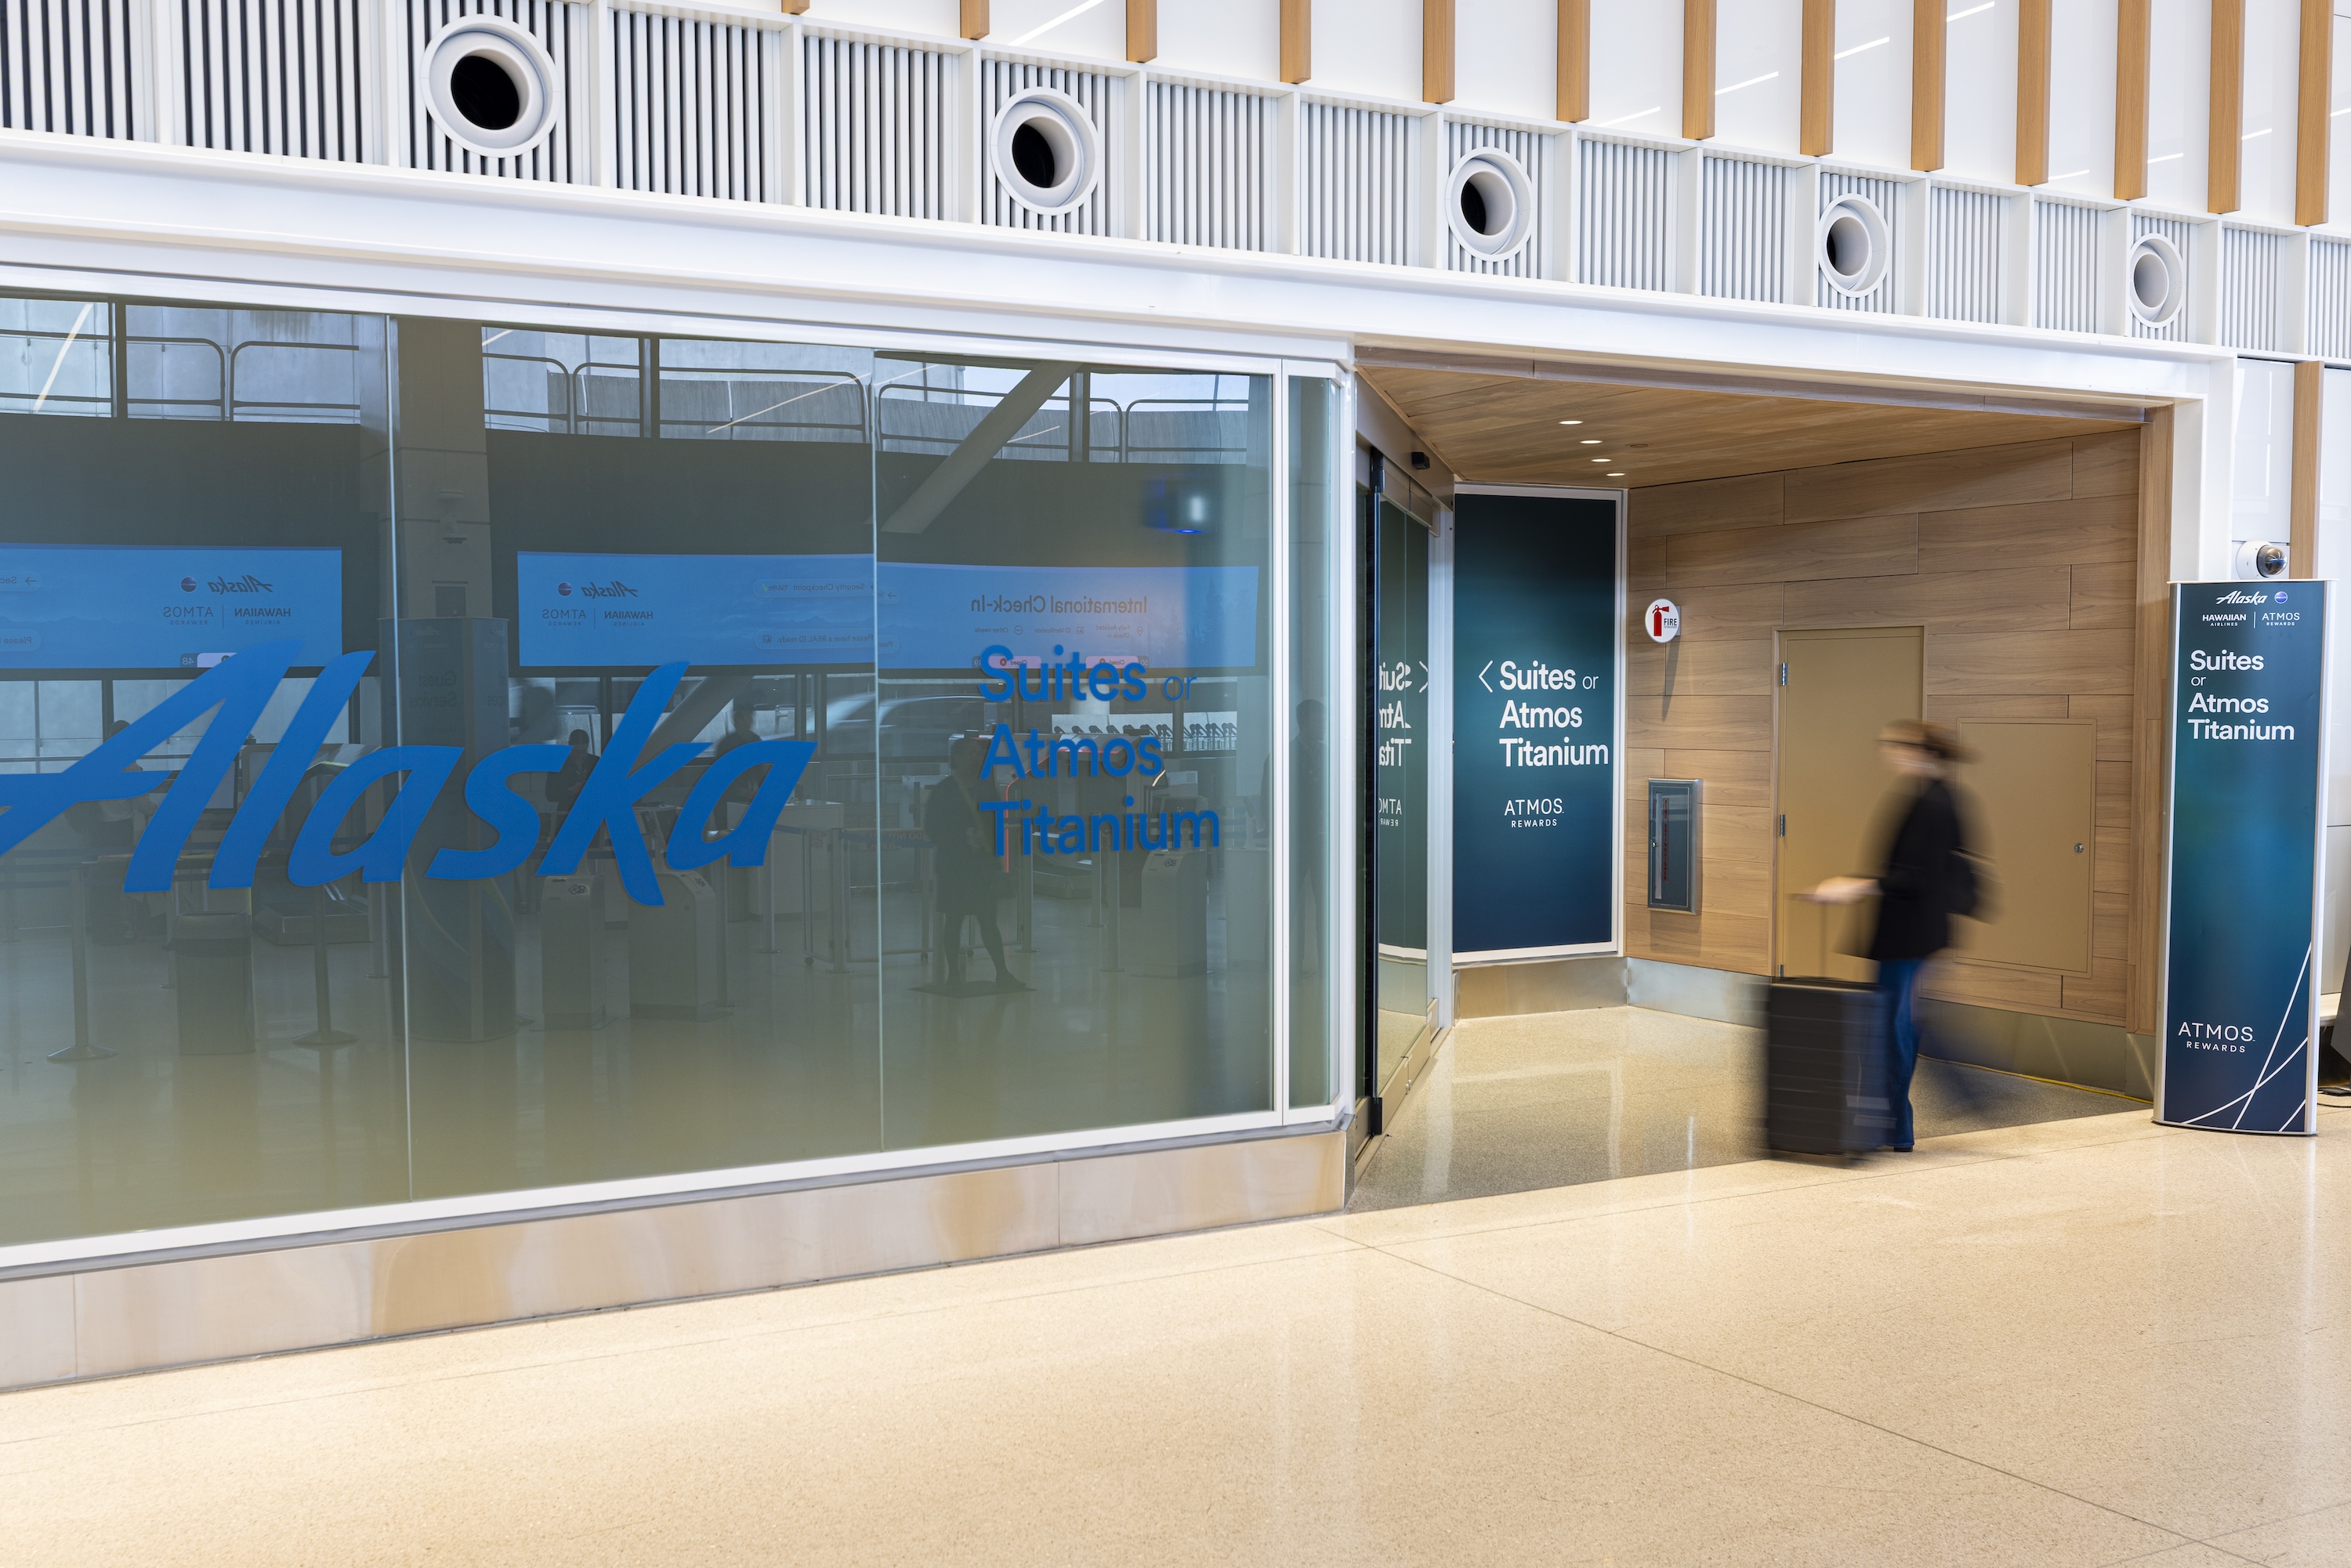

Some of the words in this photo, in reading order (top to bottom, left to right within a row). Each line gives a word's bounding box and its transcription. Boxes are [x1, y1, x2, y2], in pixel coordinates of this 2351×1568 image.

[2215, 590, 2268, 605] Alaska
[1664, 617, 1677, 626] FIRE
[2262, 612, 2300, 621] ATMOS
[2190, 649, 2264, 671] Suites
[979, 644, 1147, 702] Suites
[1163, 675, 1197, 701] or
[1499, 661, 1576, 690] Suites
[1581, 673, 1599, 690] or
[2190, 675, 2206, 686] or
[2188, 692, 2269, 714] Atmos
[1499, 700, 1583, 729] Atmos
[2187, 719, 2295, 741] Titanium
[979, 723, 1163, 780] Atmos
[1499, 737, 1609, 767] Titanium
[0, 639, 817, 906] Alaska
[1504, 798, 1563, 817] ATMOS
[979, 795, 1220, 856] Titanium
[1511, 818, 1557, 828] REWARDS
[2178, 1021, 2254, 1042] ATMOS
[2186, 1041, 2246, 1053] REWARDS
